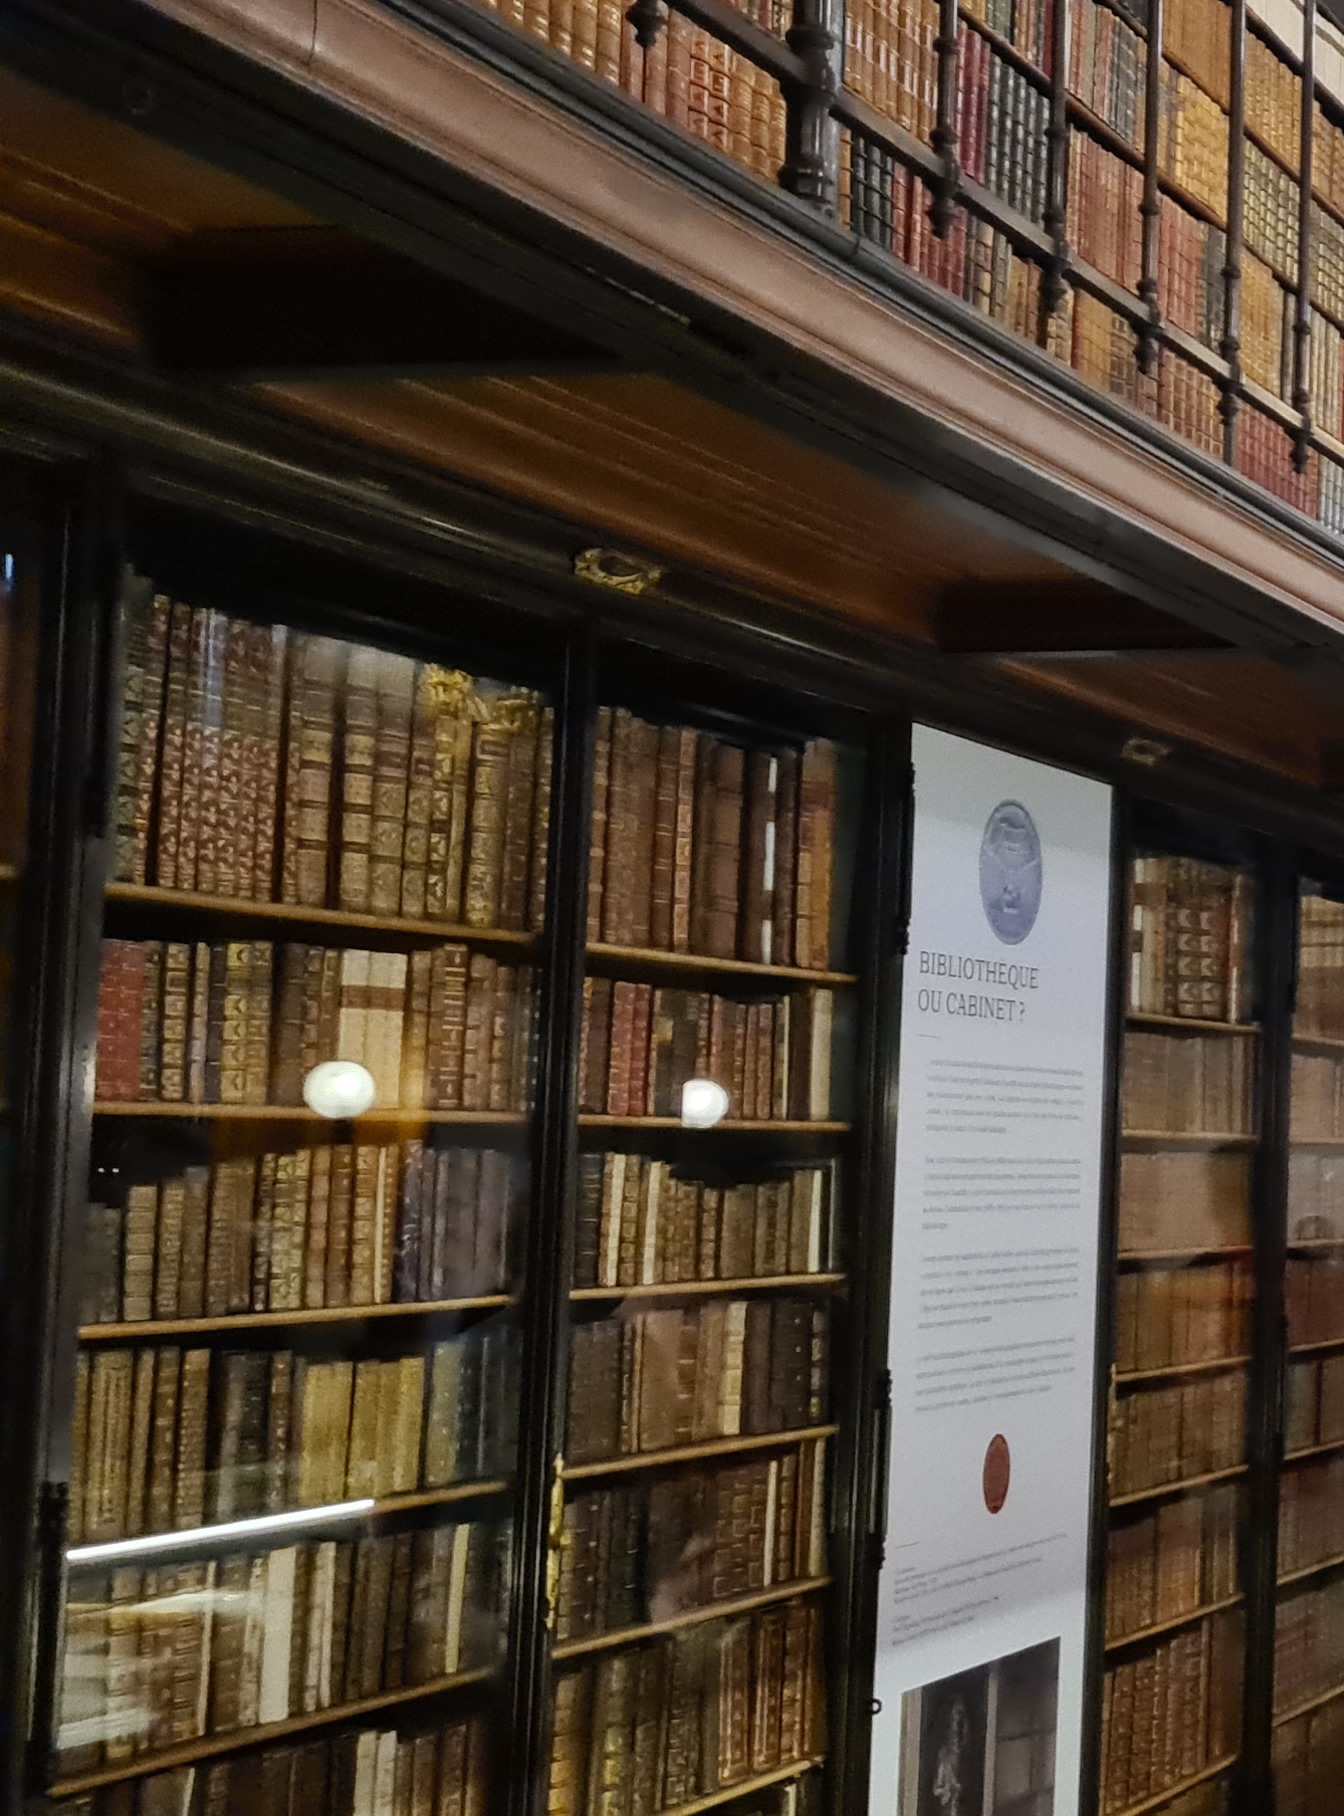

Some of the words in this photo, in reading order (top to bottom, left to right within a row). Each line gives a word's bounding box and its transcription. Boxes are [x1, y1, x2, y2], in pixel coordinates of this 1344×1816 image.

[919, 950, 1039, 990] BIBLIOTHÈQUE
[918, 988, 942, 1013] OU
[946, 991, 1016, 1022] CABINET
[1019, 1001, 1026, 1022] ?
